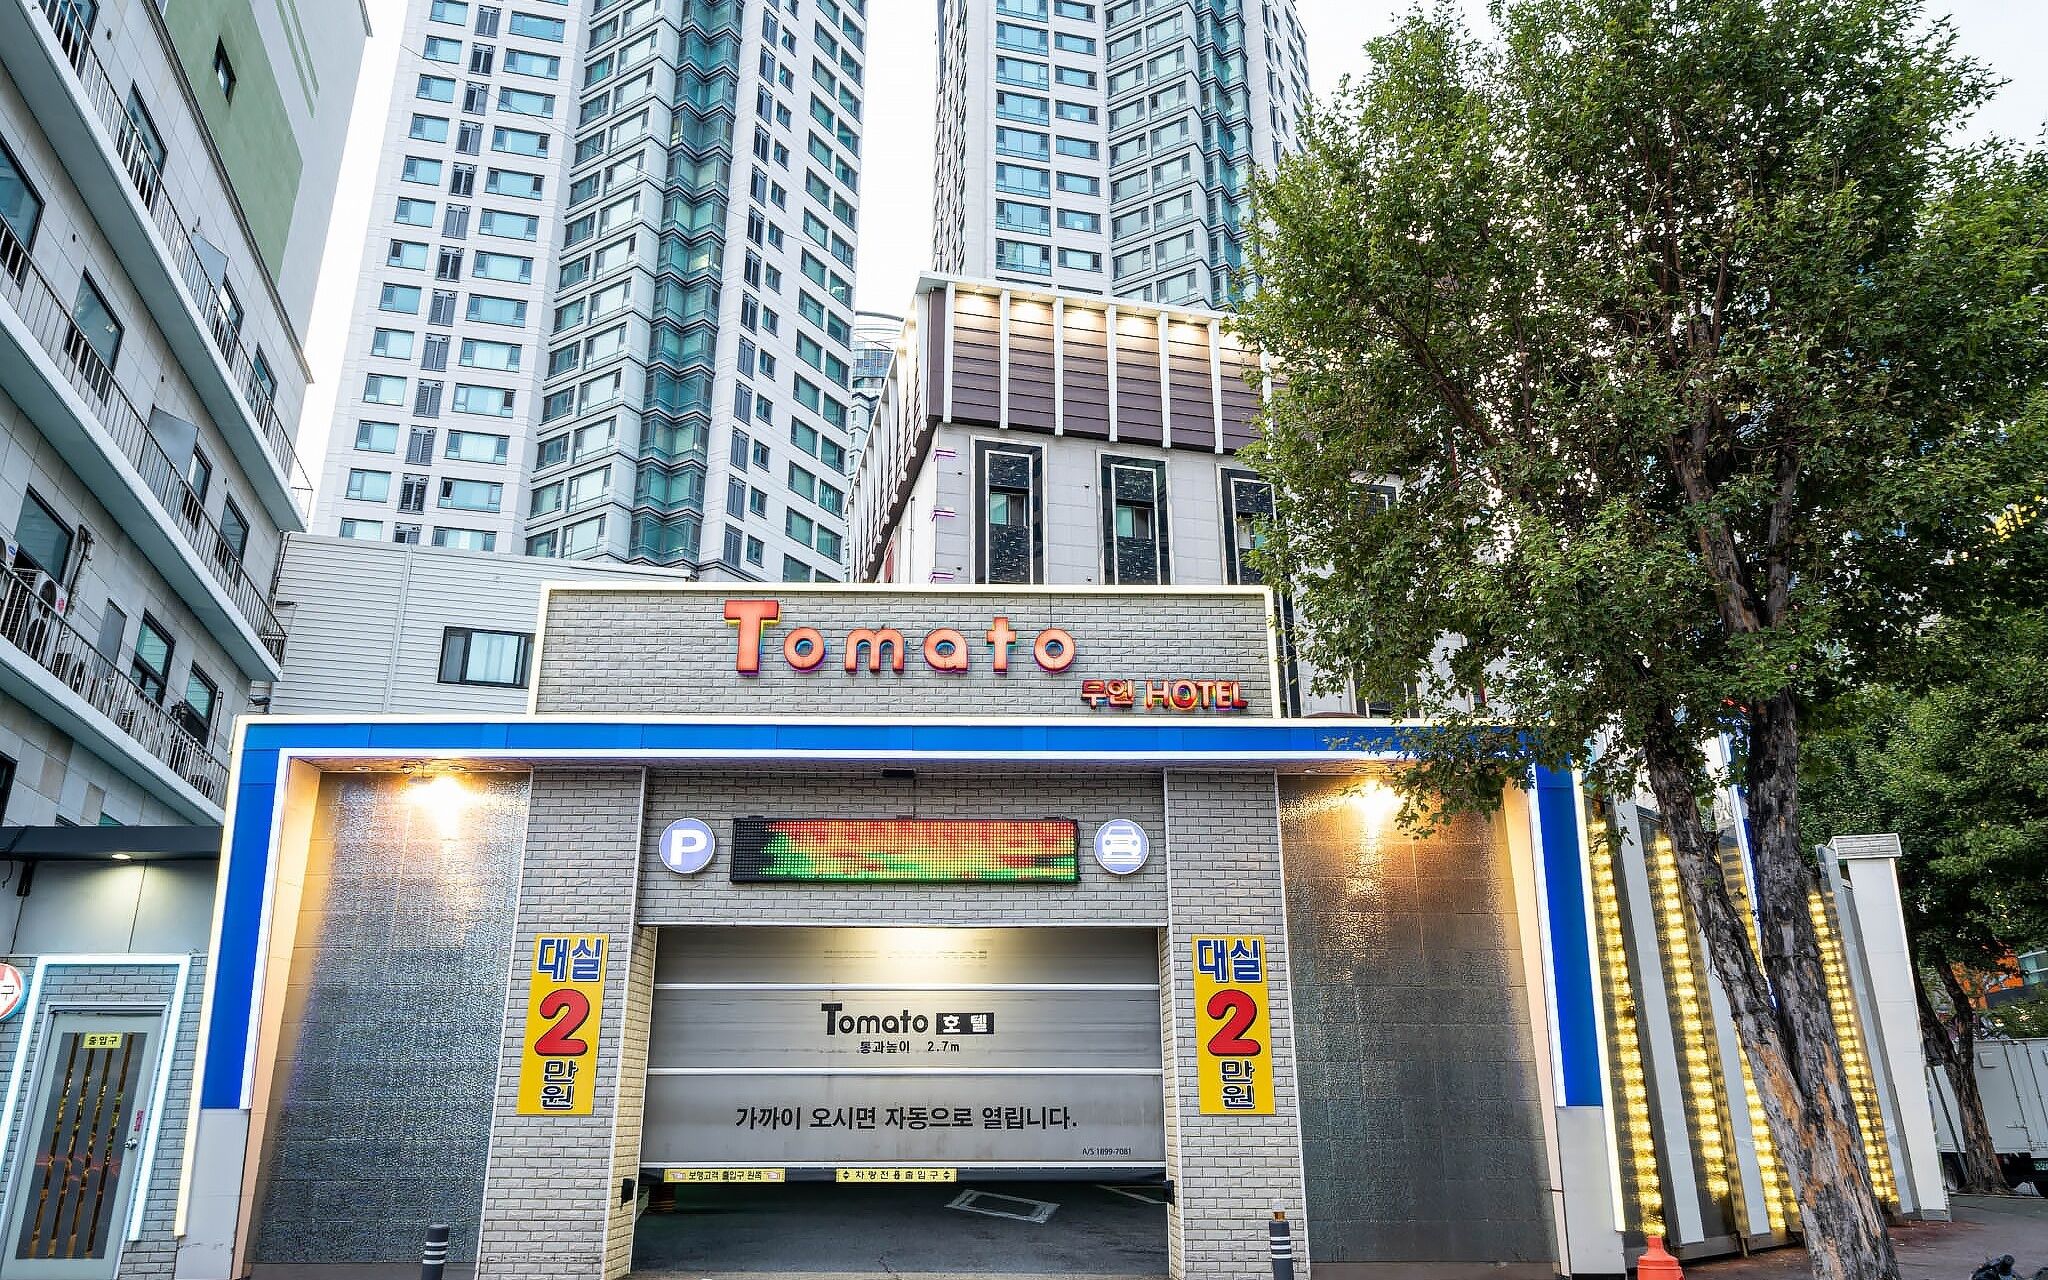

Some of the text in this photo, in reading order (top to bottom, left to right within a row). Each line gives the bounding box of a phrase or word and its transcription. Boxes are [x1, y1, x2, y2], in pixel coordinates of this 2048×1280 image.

[724, 600, 1076, 677] Tomato
[1082, 679, 1248, 711] 무인 HOTEL
[670, 829, 707, 866] P
[537, 938, 603, 982] 대실
[1197, 939, 1262, 983] 대실
[534, 989, 590, 1056] 2
[821, 1003, 929, 1035] Tomato
[1207, 989, 1261, 1057] 2
[859, 1041, 960, 1054] 통과높이 2.7m
[541, 1059, 578, 1110] 만원
[1221, 1060, 1256, 1110] 만원
[735, 1106, 1079, 1131] 가까이 오시면 자동으로 열립니다.
